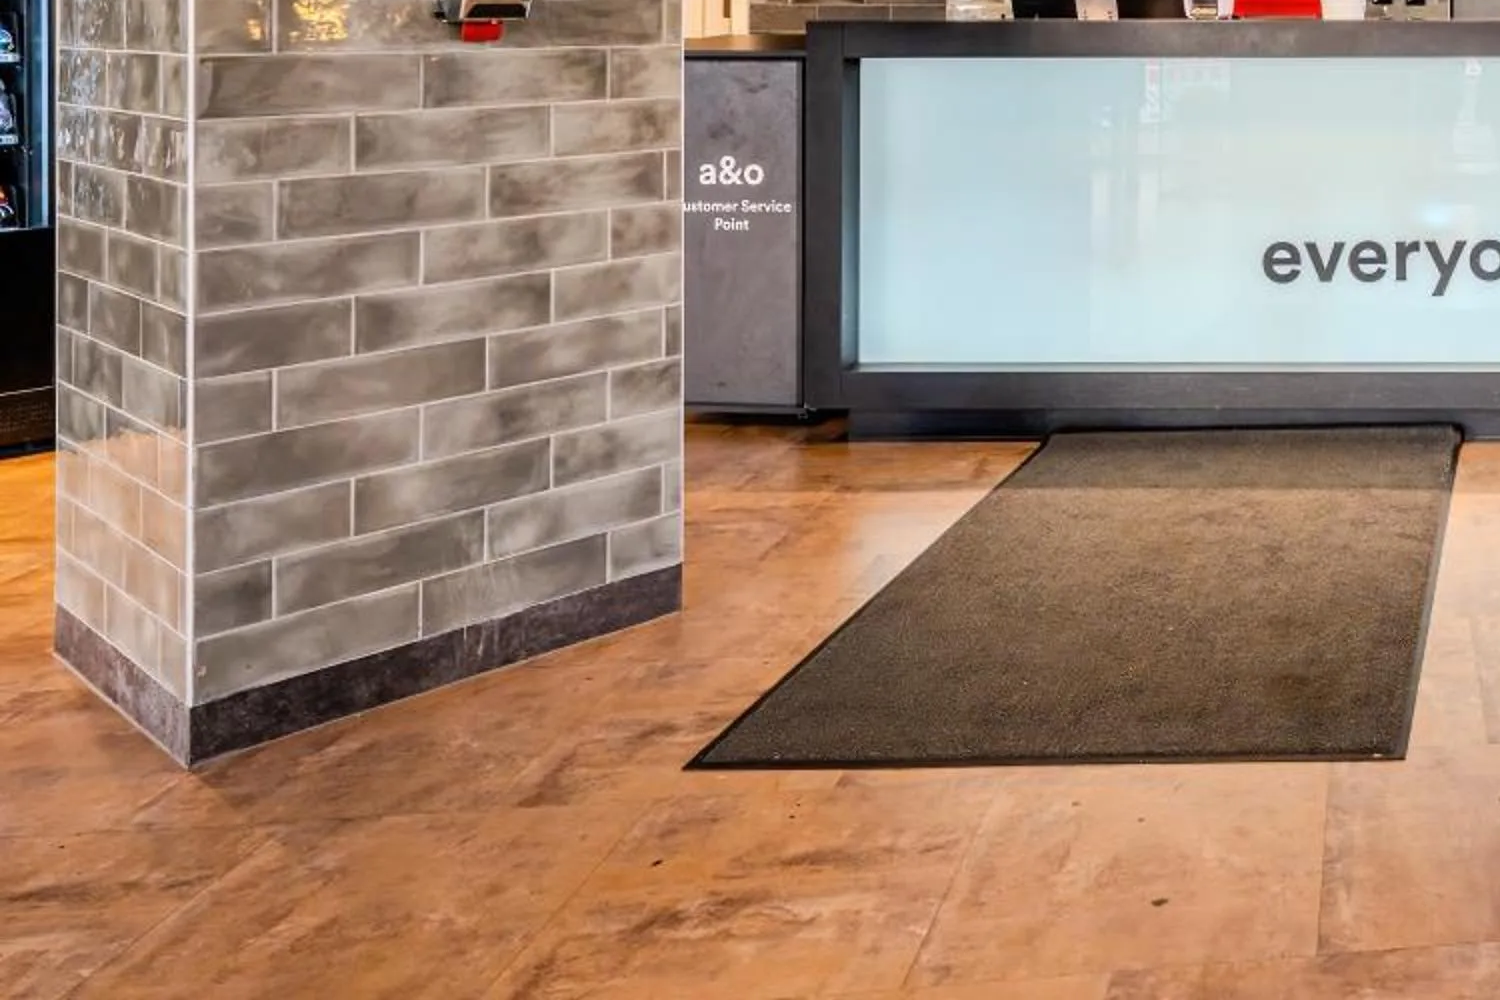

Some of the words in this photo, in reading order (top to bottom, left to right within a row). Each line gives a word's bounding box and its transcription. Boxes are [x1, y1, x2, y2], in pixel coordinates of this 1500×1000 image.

[699, 155, 765, 186] a&o
[683, 200, 739, 213] ustomer
[741, 200, 792, 213] Service
[714, 217, 750, 231] Point
